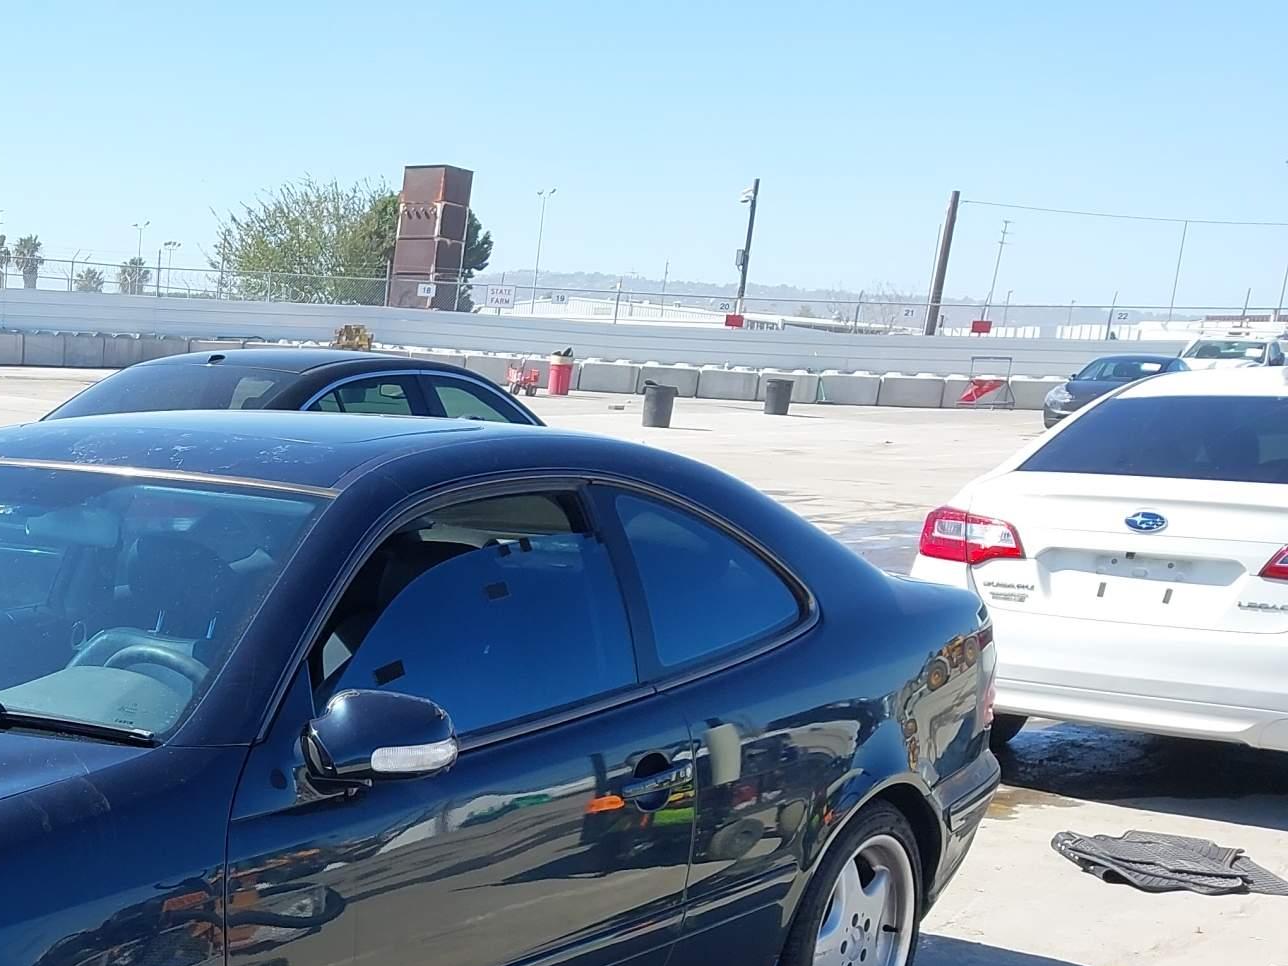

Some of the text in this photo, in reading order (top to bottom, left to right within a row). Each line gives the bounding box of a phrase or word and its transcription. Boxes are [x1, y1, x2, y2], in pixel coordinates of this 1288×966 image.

[423, 286, 432, 294] 18
[490, 297, 510, 305] FARM
[719, 302, 730, 310] 20
[904, 309, 914, 317] 21
[1117, 312, 1129, 320] 22
